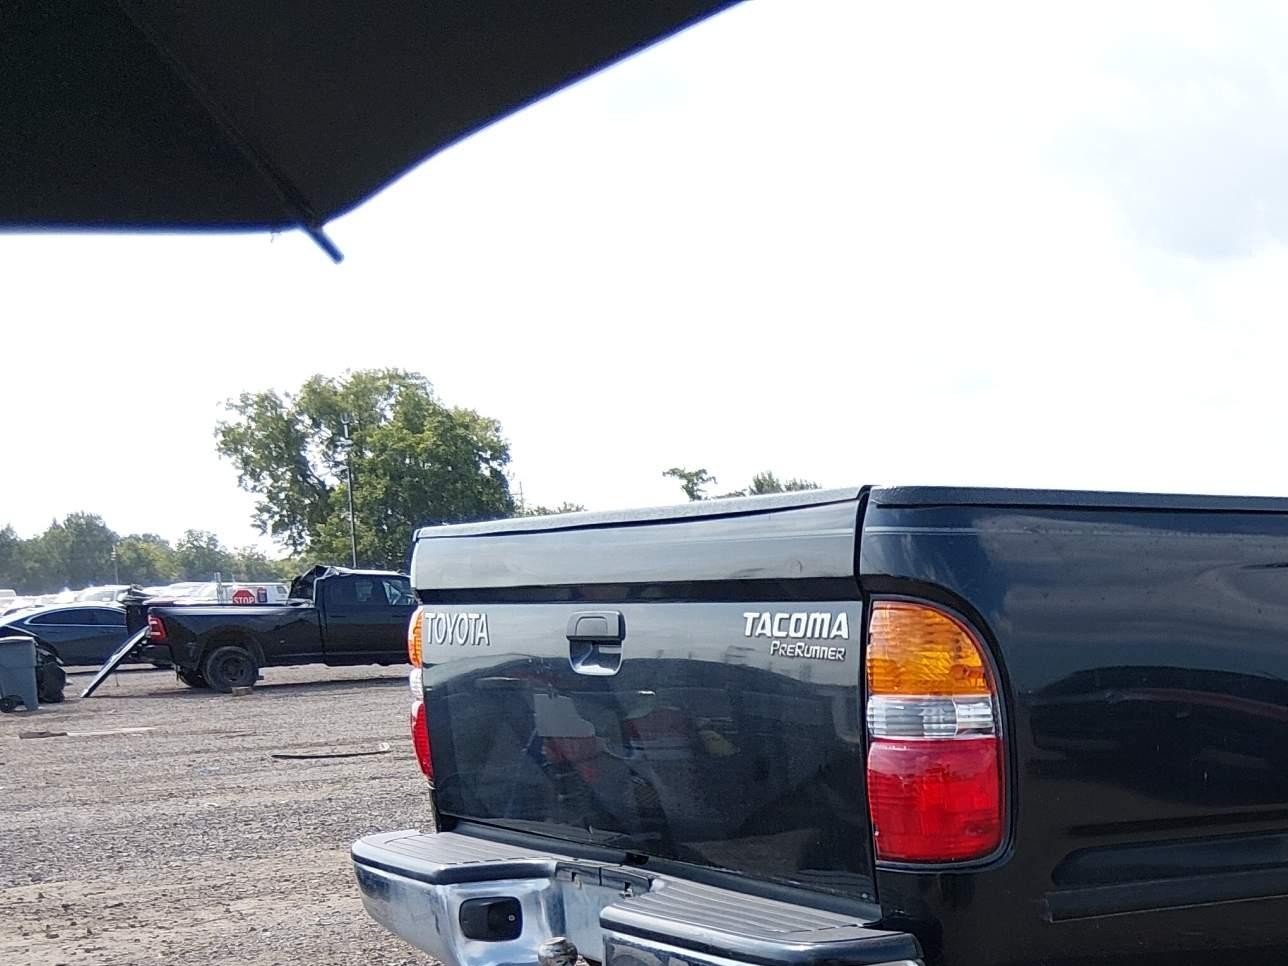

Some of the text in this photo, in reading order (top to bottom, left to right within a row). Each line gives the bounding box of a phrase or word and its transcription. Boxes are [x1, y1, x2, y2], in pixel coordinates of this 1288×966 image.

[233, 596, 255, 604] STOP
[425, 612, 490, 646] TOYOTA
[743, 611, 849, 639] TACOMA
